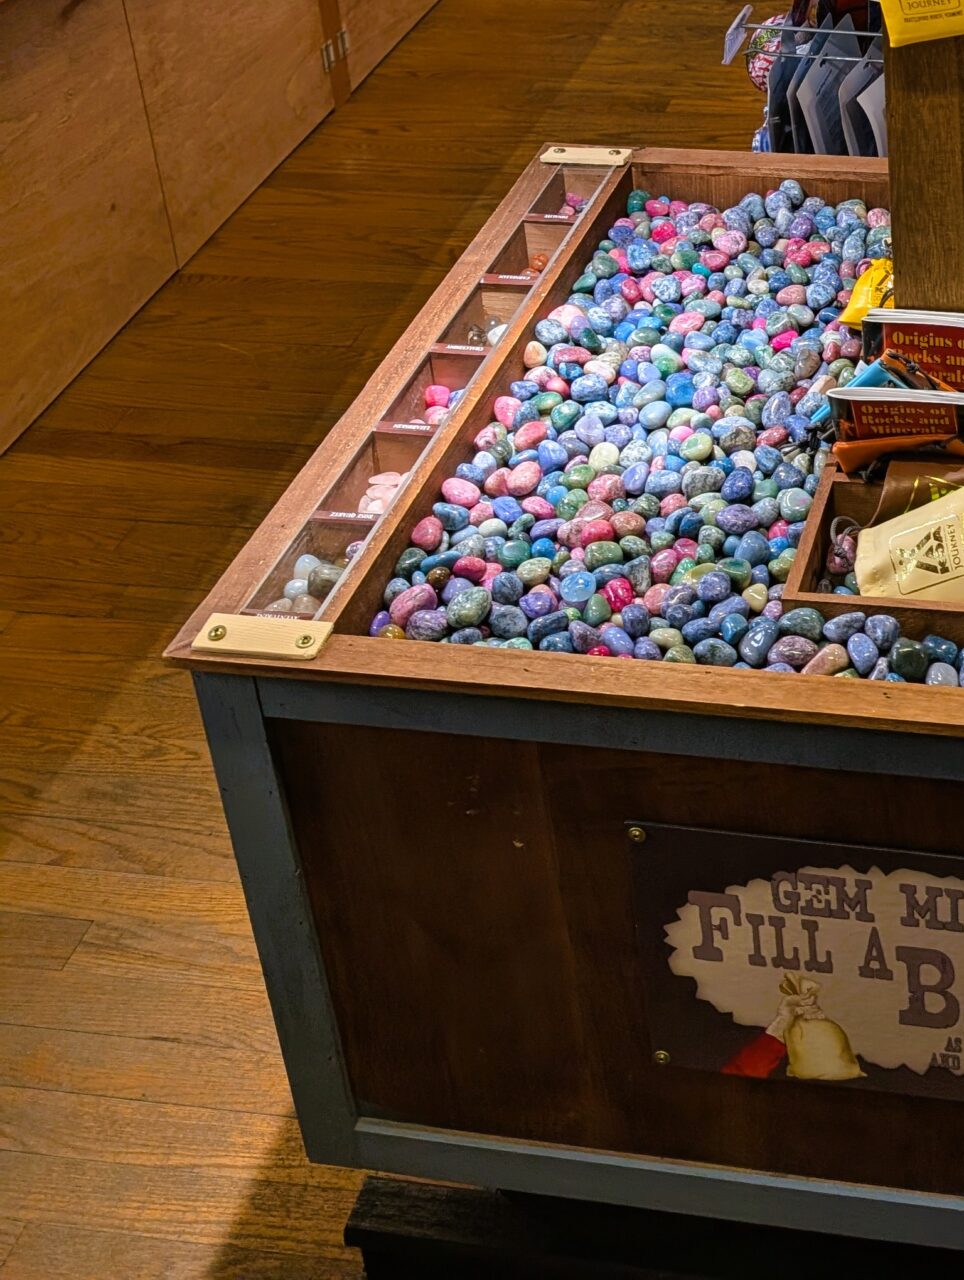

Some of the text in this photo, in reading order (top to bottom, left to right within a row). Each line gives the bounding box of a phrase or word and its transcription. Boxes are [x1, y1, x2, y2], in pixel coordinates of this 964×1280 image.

[892, 331, 952, 349] Origins
[861, 404, 947, 416] Origins of
[861, 415, 950, 426] Rocks and
[871, 423, 945, 435] Minerals
[947, 524, 964, 571] JOURNEY
[771, 870, 875, 923] GEM
[687, 889, 834, 974] FILL
[858, 926, 894, 980] A
[944, 1037, 962, 1053] AS
[930, 1052, 961, 1071] AND
